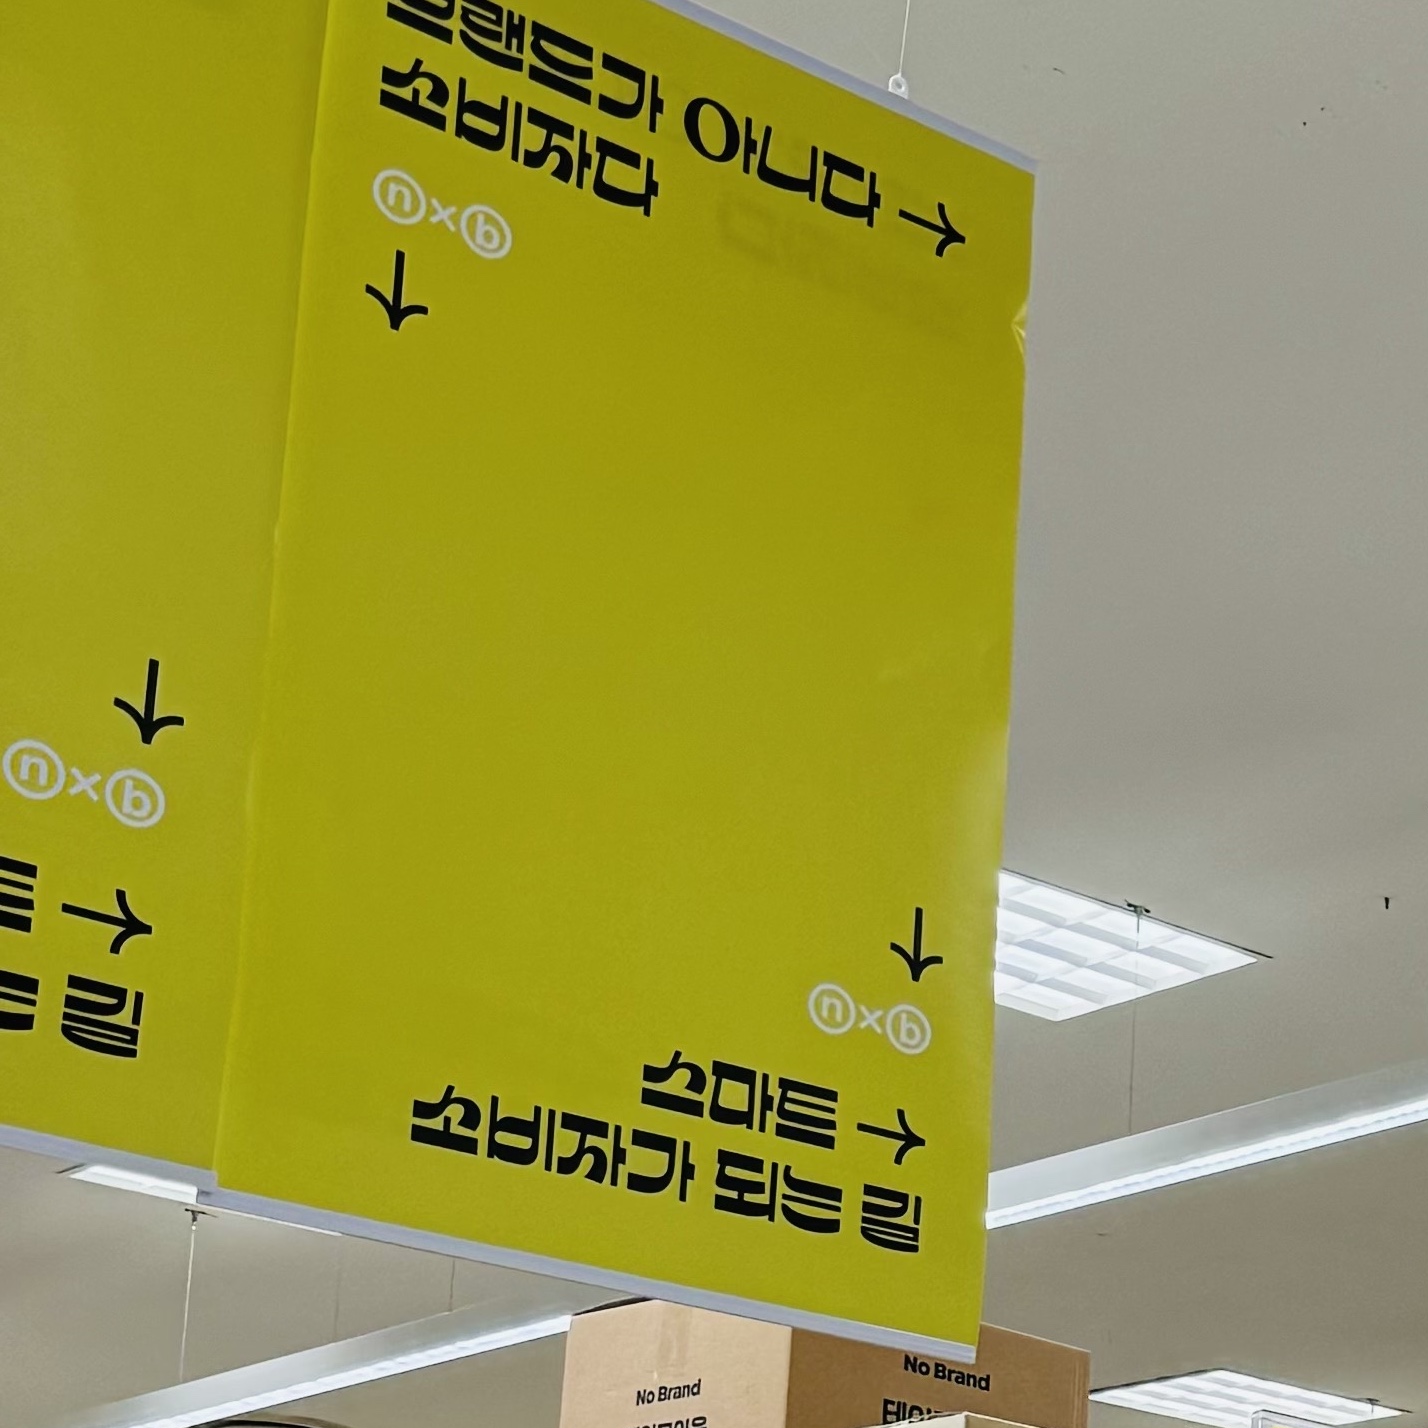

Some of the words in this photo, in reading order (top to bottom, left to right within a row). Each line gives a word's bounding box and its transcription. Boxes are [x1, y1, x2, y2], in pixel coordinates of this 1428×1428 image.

[380, 58, 658, 217] 소비자다
[684, 97, 881, 228] 아니다
[62, 975, 144, 1058] 길
[641, 1050, 838, 1151] 스마트
[411, 1084, 695, 1202] 소비자가
[714, 1149, 843, 1234] 되는
[860, 1183, 922, 1253] 길
[636, 1389, 655, 1406] No
[658, 1378, 702, 1402] Brand
[904, 1354, 931, 1377] No
[934, 1361, 991, 1392] Brand
